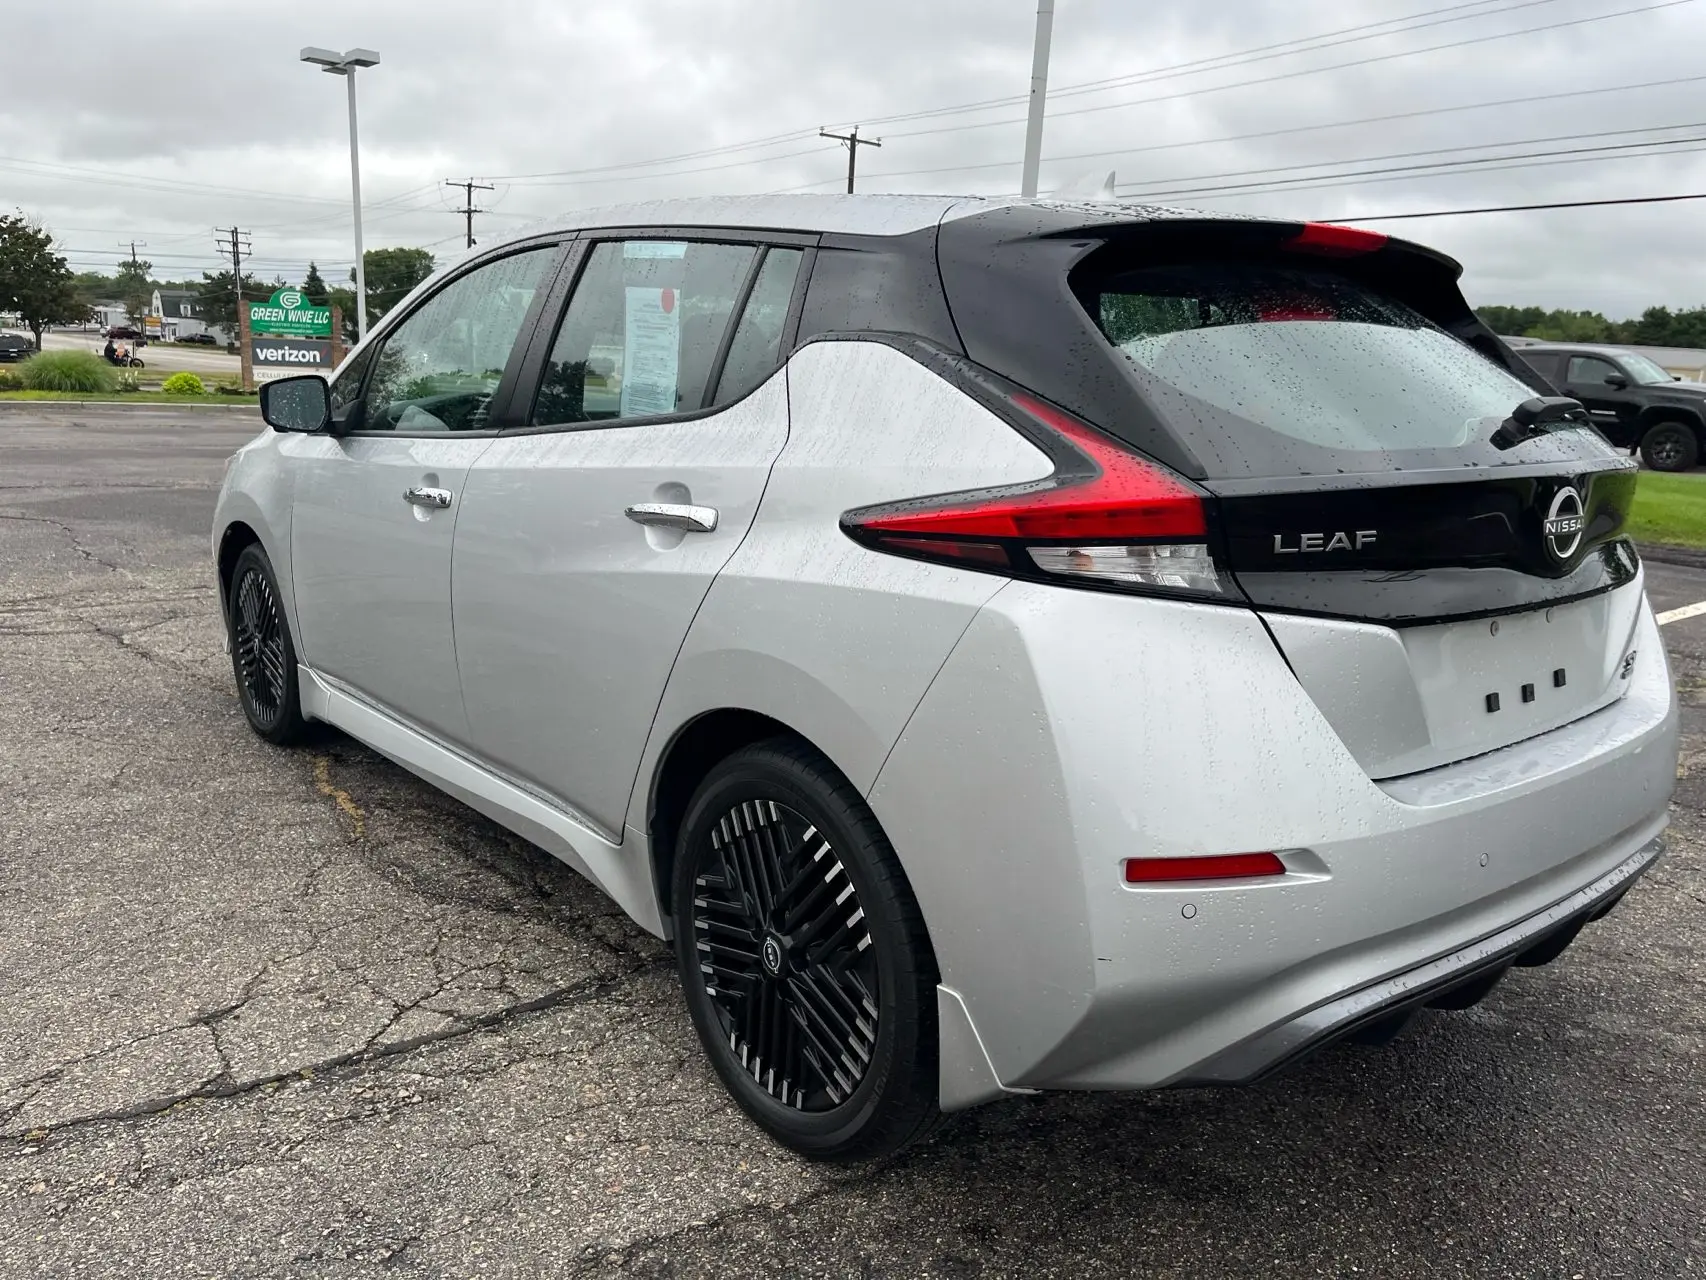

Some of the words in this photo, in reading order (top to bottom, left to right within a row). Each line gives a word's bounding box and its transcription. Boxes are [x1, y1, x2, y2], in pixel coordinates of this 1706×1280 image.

[251, 307, 286, 321] GREEN
[288, 309, 313, 324] WAVE
[314, 311, 330, 324] LLC
[256, 346, 321, 363] verizon
[1545, 519, 1584, 533] NISSA
[1273, 530, 1377, 554] LEAF
